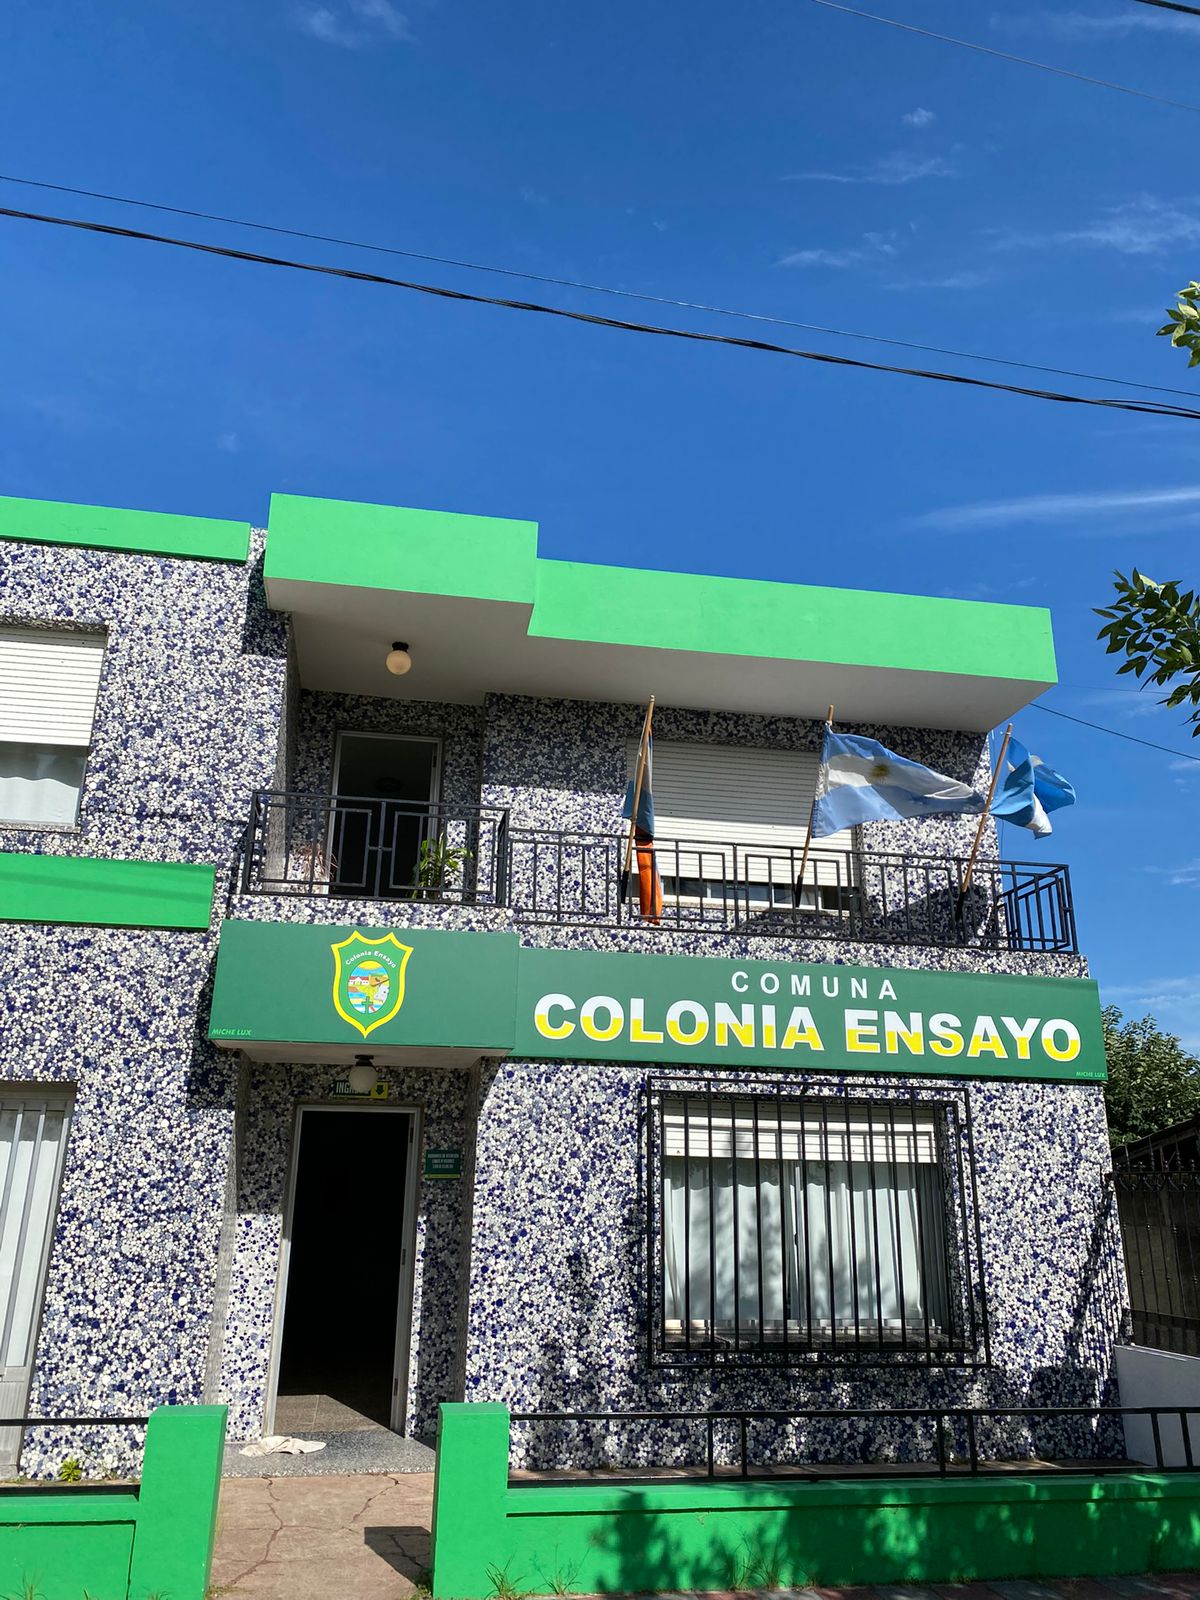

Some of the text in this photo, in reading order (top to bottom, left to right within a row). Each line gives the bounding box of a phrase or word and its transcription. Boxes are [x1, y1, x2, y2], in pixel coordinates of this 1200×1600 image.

[345, 950, 396, 968] Colonia Ensayo
[731, 971, 898, 1000] COMUNA
[534, 993, 1081, 1061] COLONIA ENSAYO
